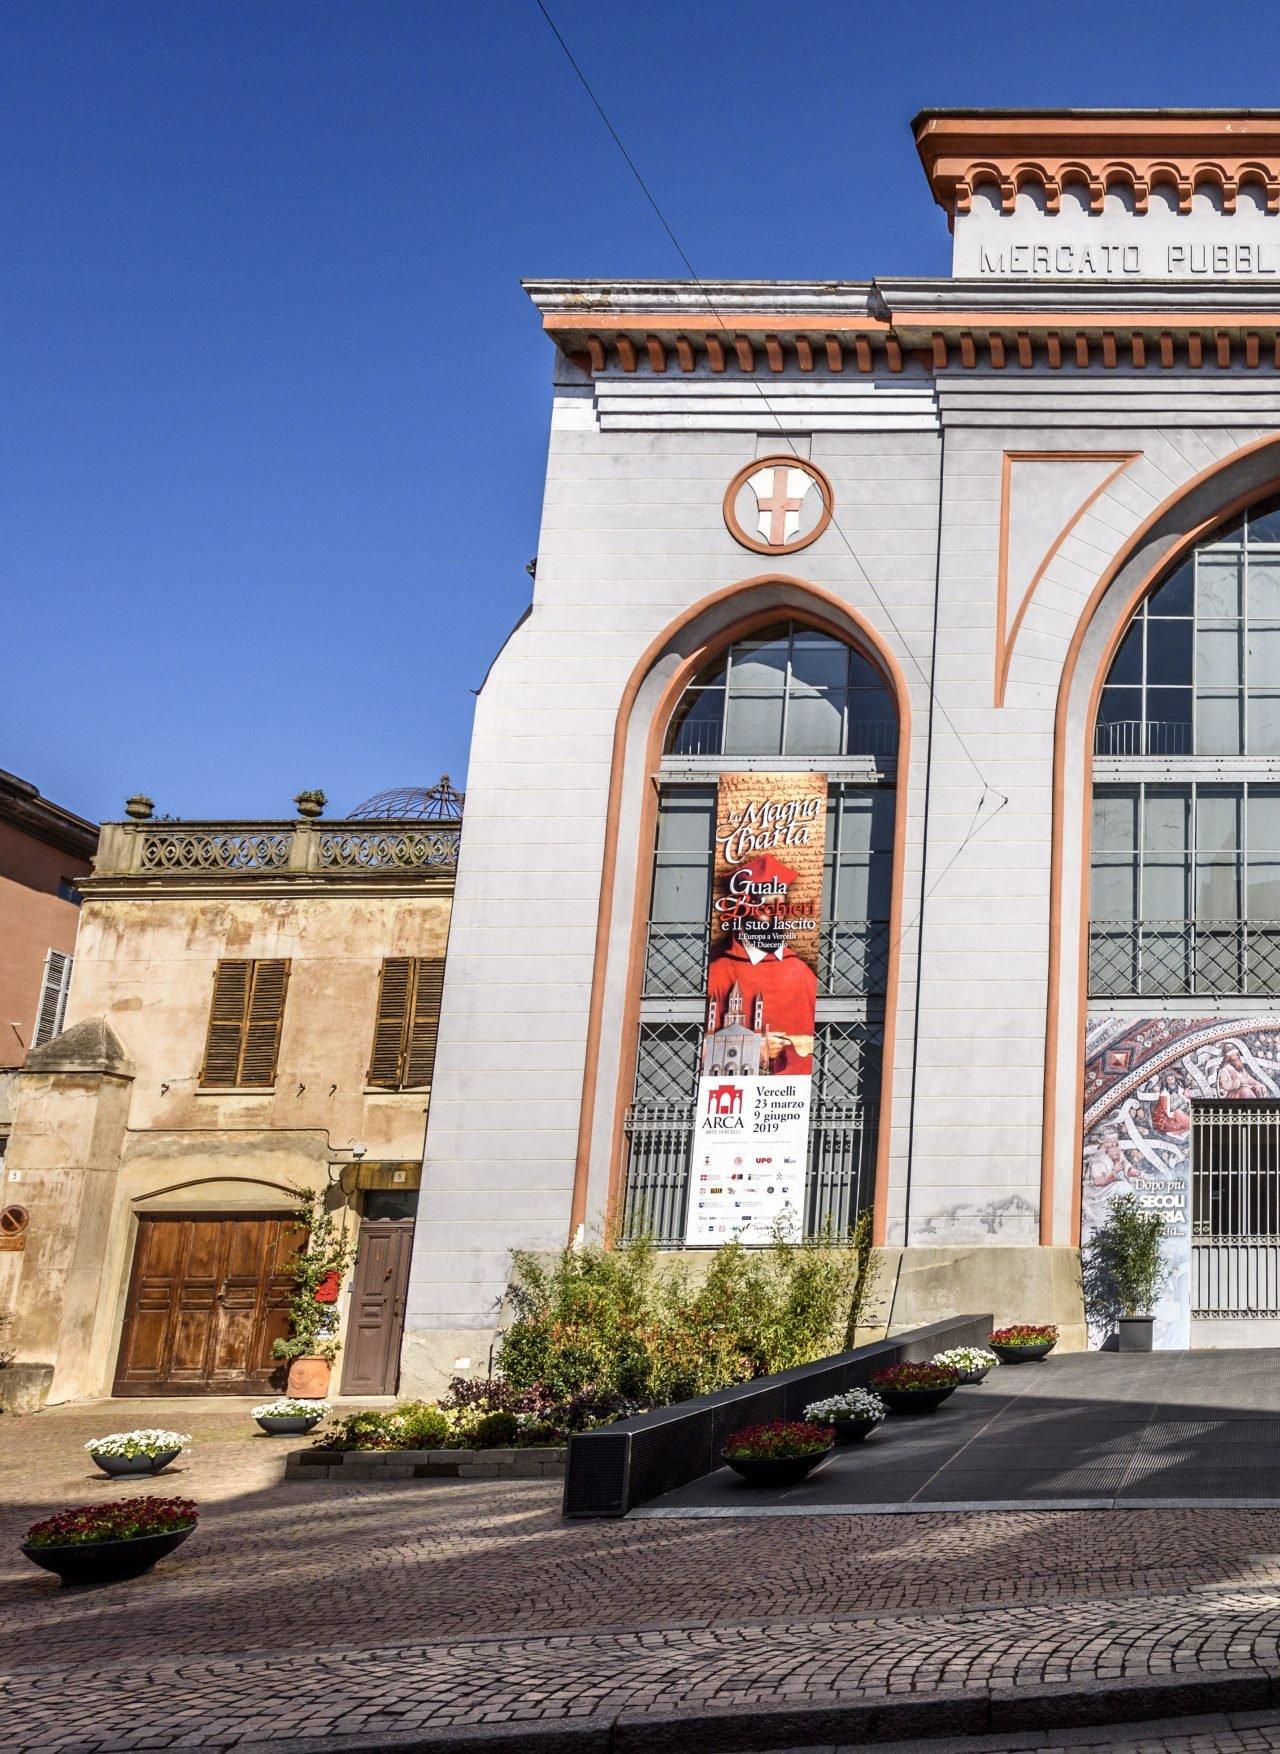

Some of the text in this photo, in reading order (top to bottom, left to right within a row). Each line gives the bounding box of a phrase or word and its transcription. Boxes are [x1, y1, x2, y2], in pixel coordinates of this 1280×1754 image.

[980, 244, 1140, 273] MERCATO
[729, 799, 821, 830] La Magna
[716, 820, 815, 864] Charta
[730, 869, 787, 895] Guala
[719, 894, 816, 921] Bicchieri
[721, 916, 816, 930] e il suo lascito
[738, 933, 766, 942] L'Europa
[772, 932, 796, 940] Vercelli
[757, 941, 788, 949] Duecento
[756, 1085, 796, 1097] Vercelli
[754, 1099, 805, 1109] 23 marzo
[702, 1116, 744, 1129] ARCA
[754, 1110, 801, 1123] 9 giugno
[752, 1122, 779, 1133] 2019
[1135, 1177, 1186, 1194] Dopo più
[1139, 1194, 1185, 1208] SECOLI
